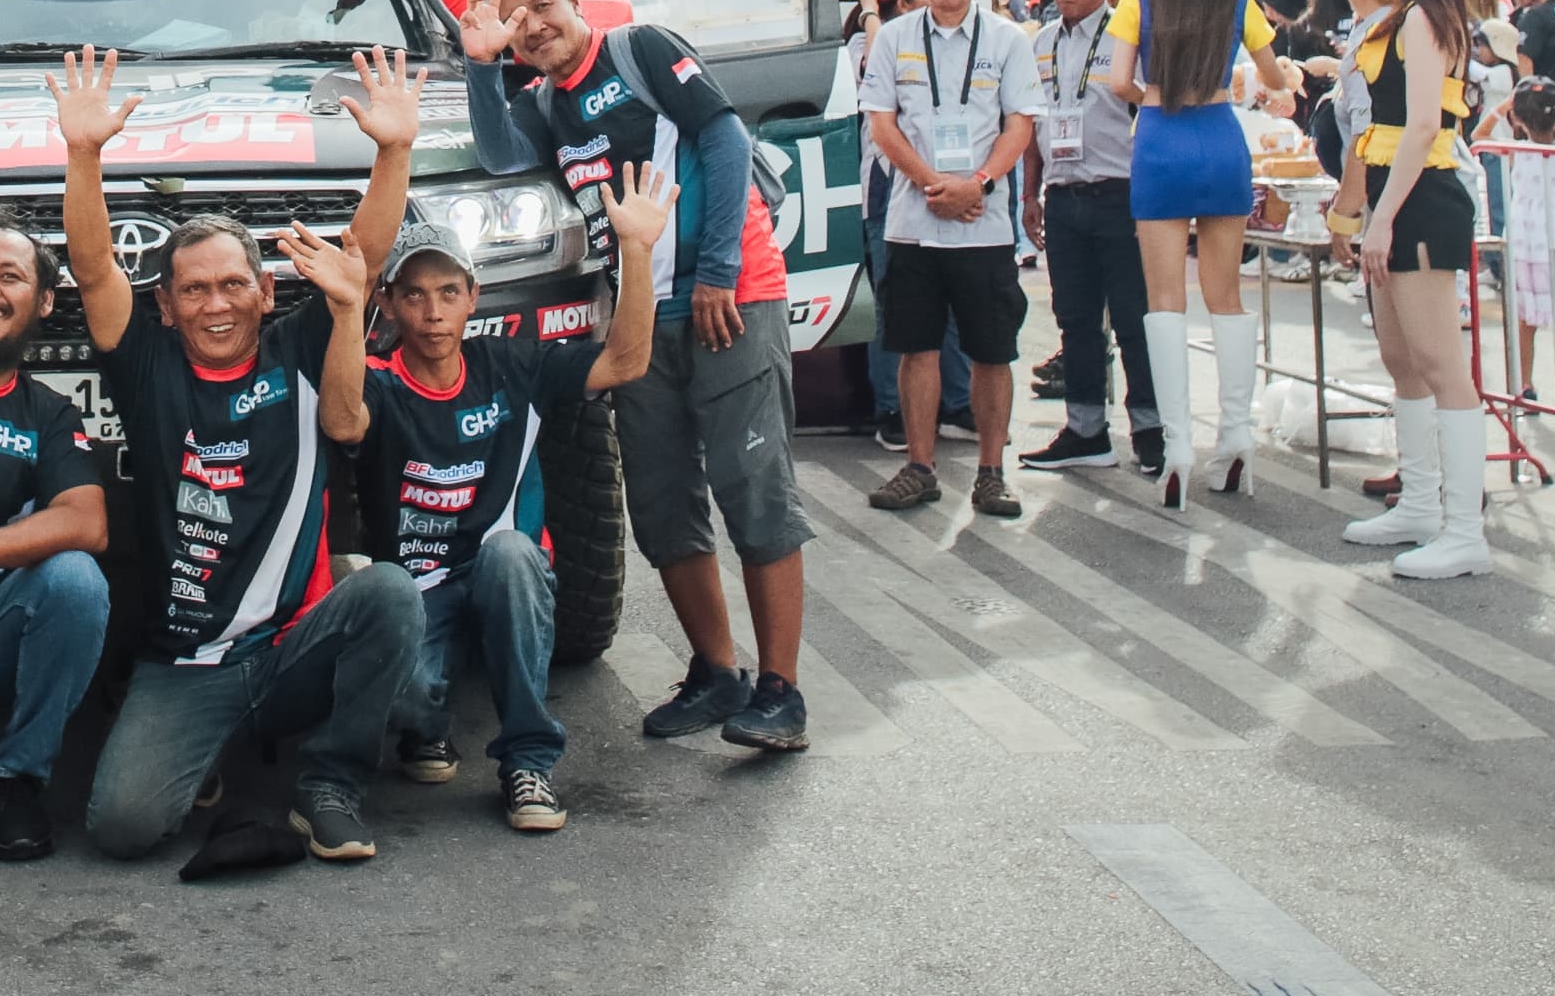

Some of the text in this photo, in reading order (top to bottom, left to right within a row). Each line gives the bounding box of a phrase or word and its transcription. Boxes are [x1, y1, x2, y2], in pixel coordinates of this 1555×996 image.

[585, 81, 621, 116] GHP
[559, 135, 609, 158] Goodrich
[566, 160, 609, 186] OTUL
[542, 302, 600, 336] MOTU
[403, 486, 472, 508] MOTUL
[177, 519, 229, 545] Belkote
[402, 511, 451, 534] Kahf
[399, 539, 449, 556] Belkote
[172, 559, 213, 582] PRO7
